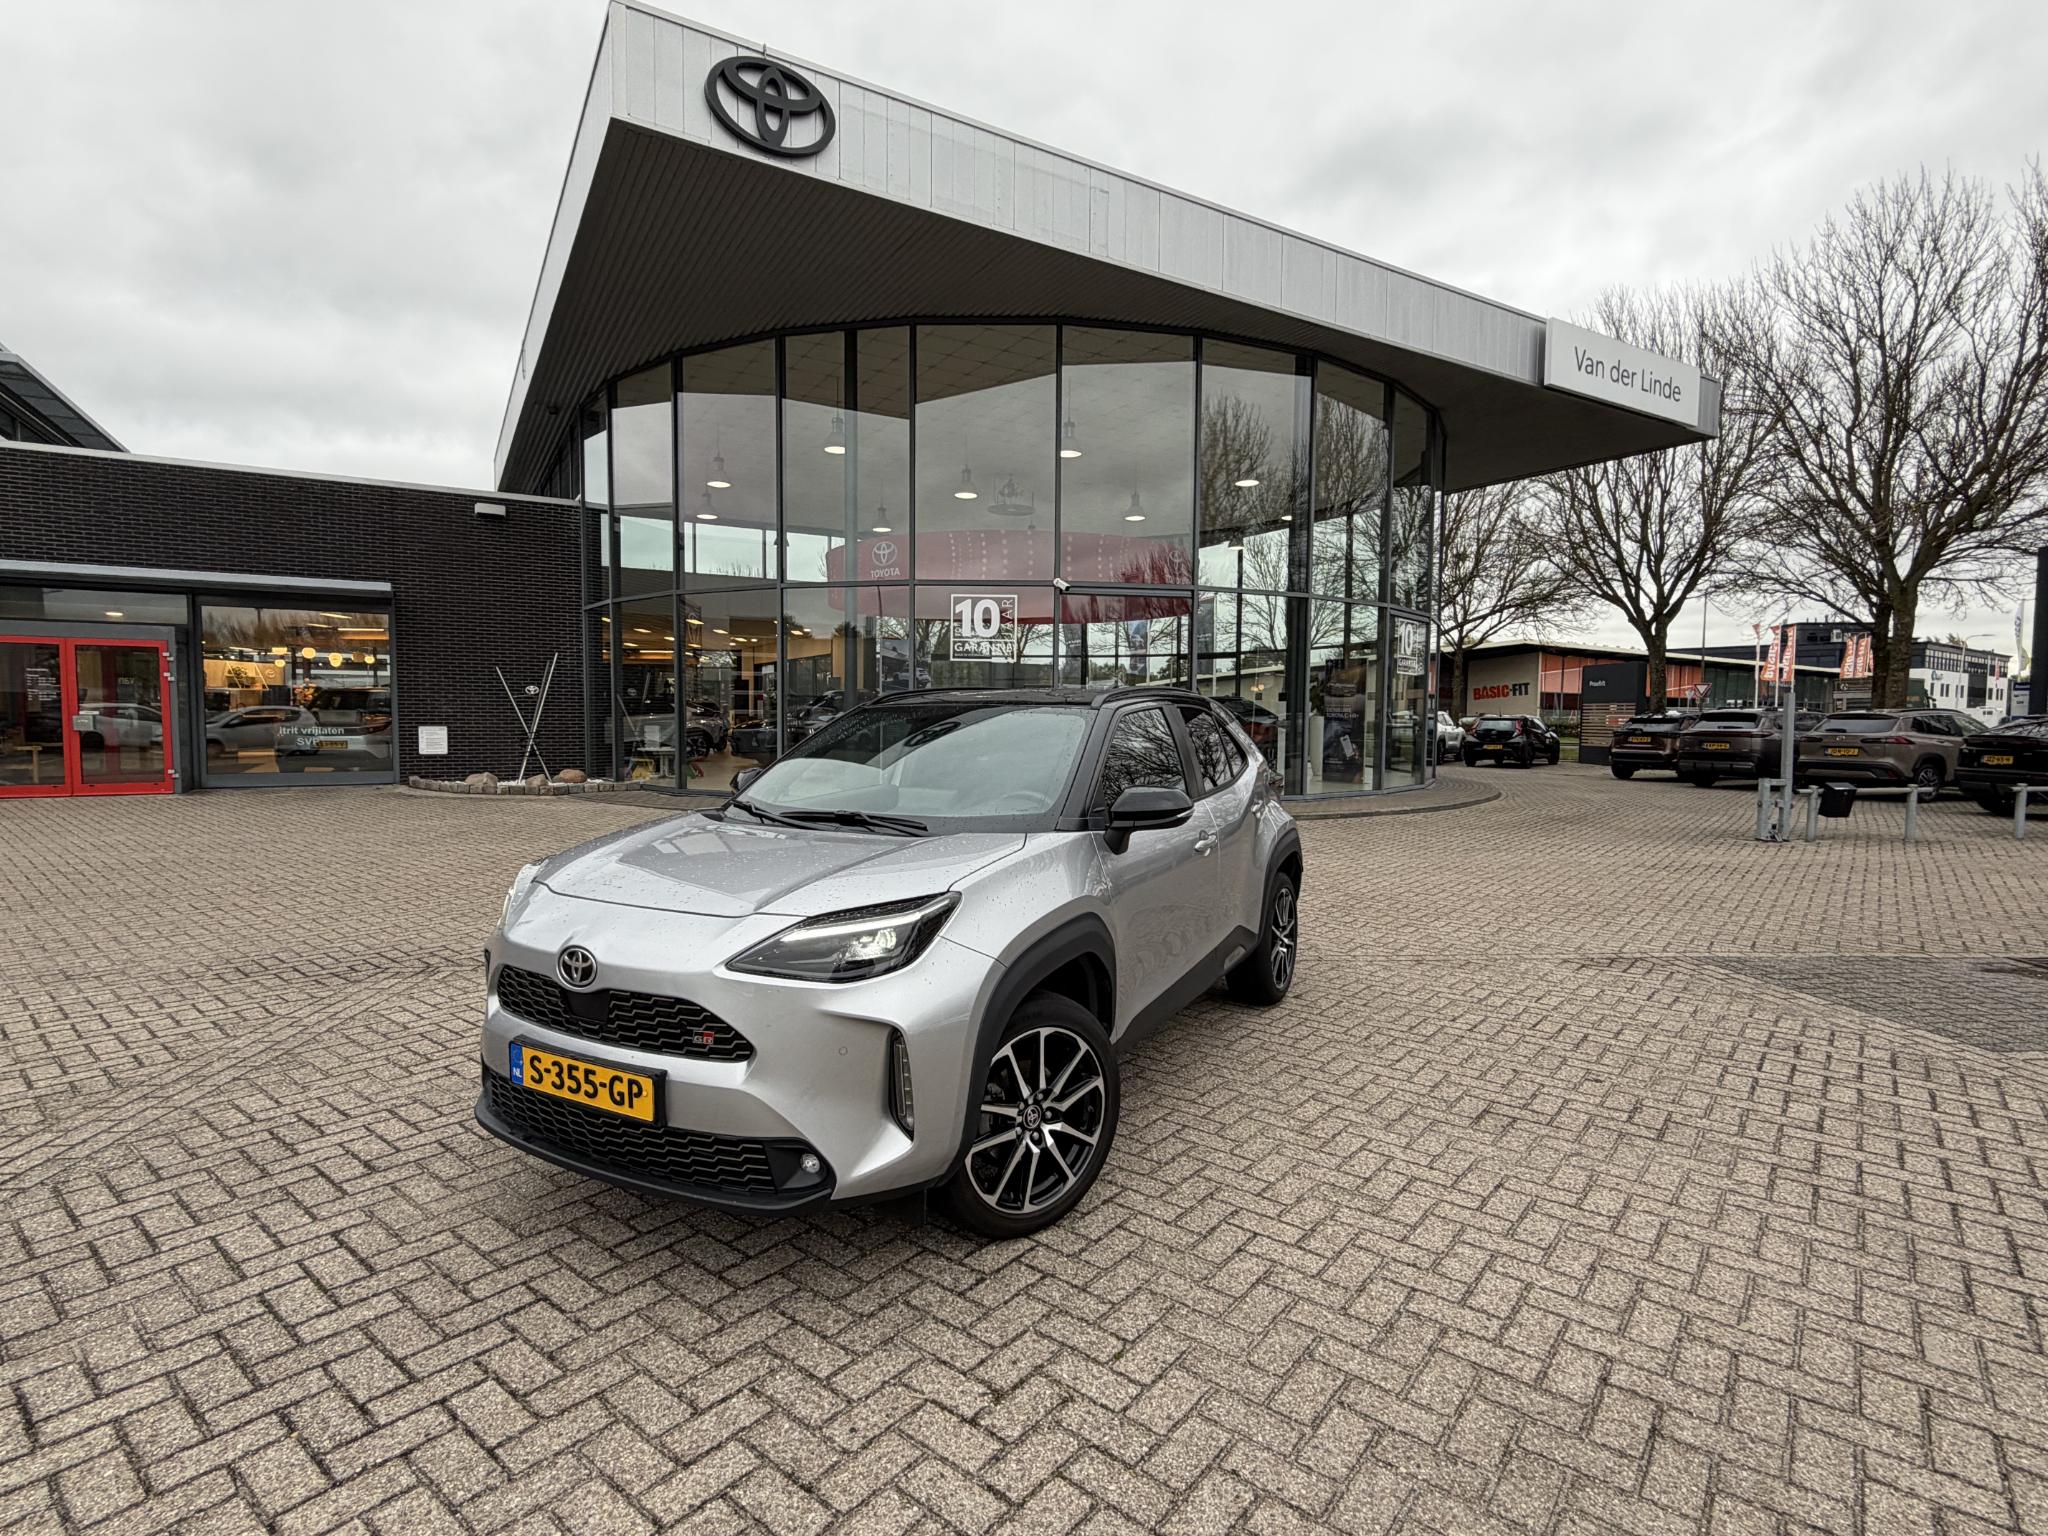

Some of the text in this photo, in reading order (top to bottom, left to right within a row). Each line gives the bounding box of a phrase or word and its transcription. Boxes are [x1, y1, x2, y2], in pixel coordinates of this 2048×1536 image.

[1574, 346, 1682, 402] Van der Linde
[871, 567, 901, 578] TOYOTA
[955, 598, 1001, 637] 10
[1001, 599, 1014, 639] JAAR
[1472, 682, 1530, 701] BASIC-FIT
[512, 1066, 523, 1078] NL
[529, 1054, 644, 1109] S-355-GP
